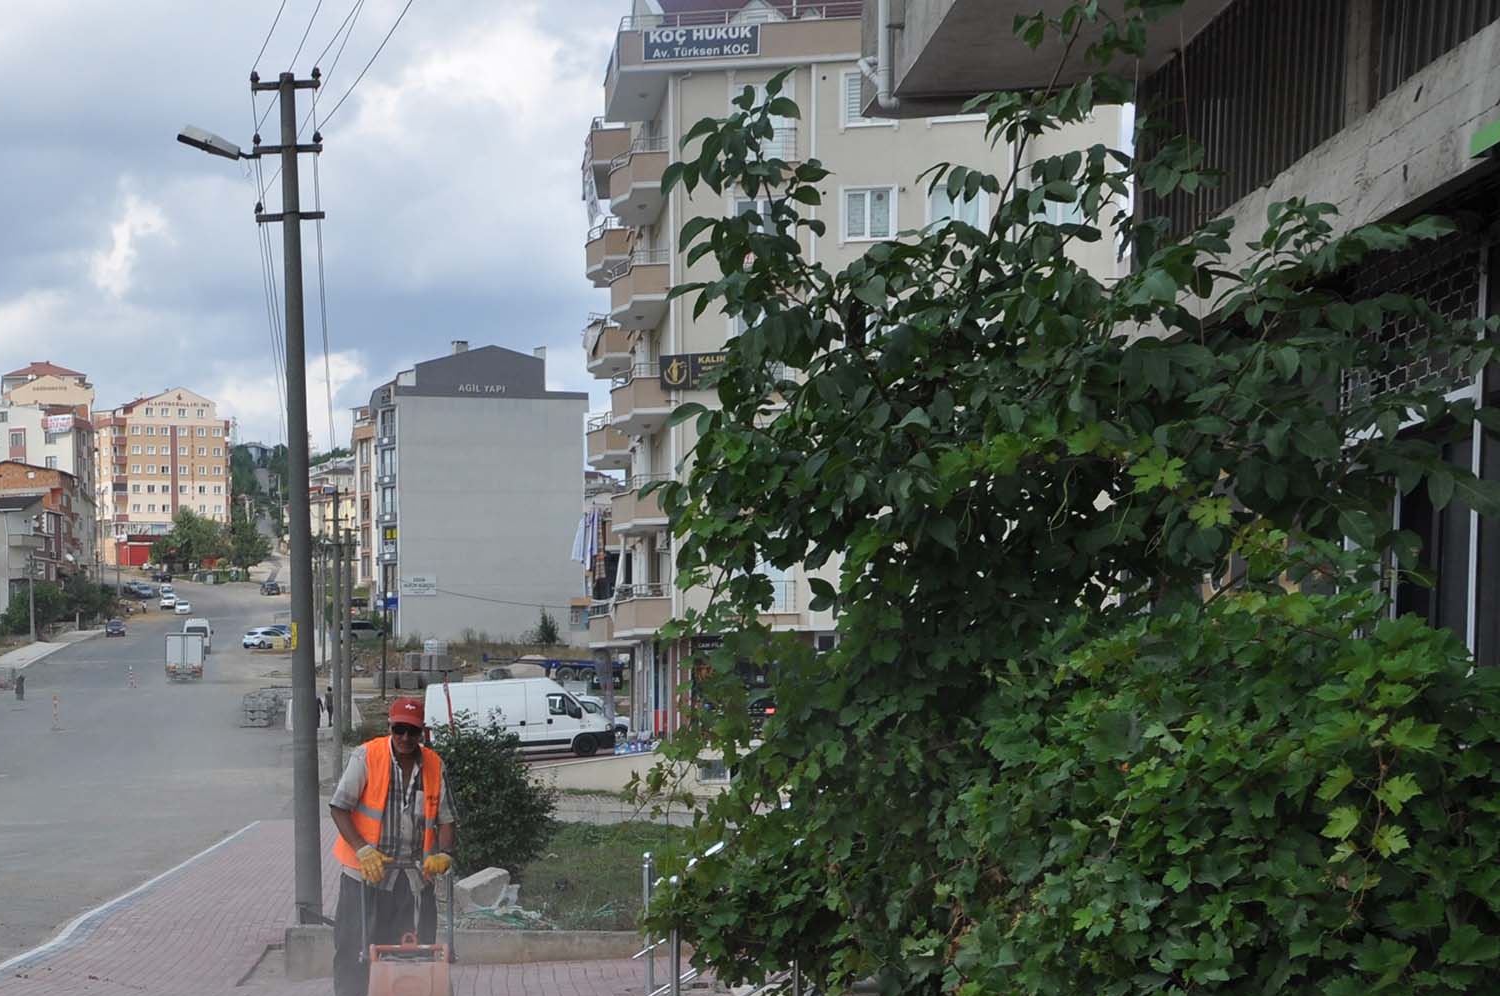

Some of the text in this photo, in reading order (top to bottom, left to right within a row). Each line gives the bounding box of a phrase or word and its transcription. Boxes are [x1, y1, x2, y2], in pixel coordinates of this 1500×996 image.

[649, 26, 752, 45] KOÇ HUKUK
[652, 48, 670, 58] Av.
[723, 43, 750, 55] KOÇ
[484, 384, 507, 393] YAPI
